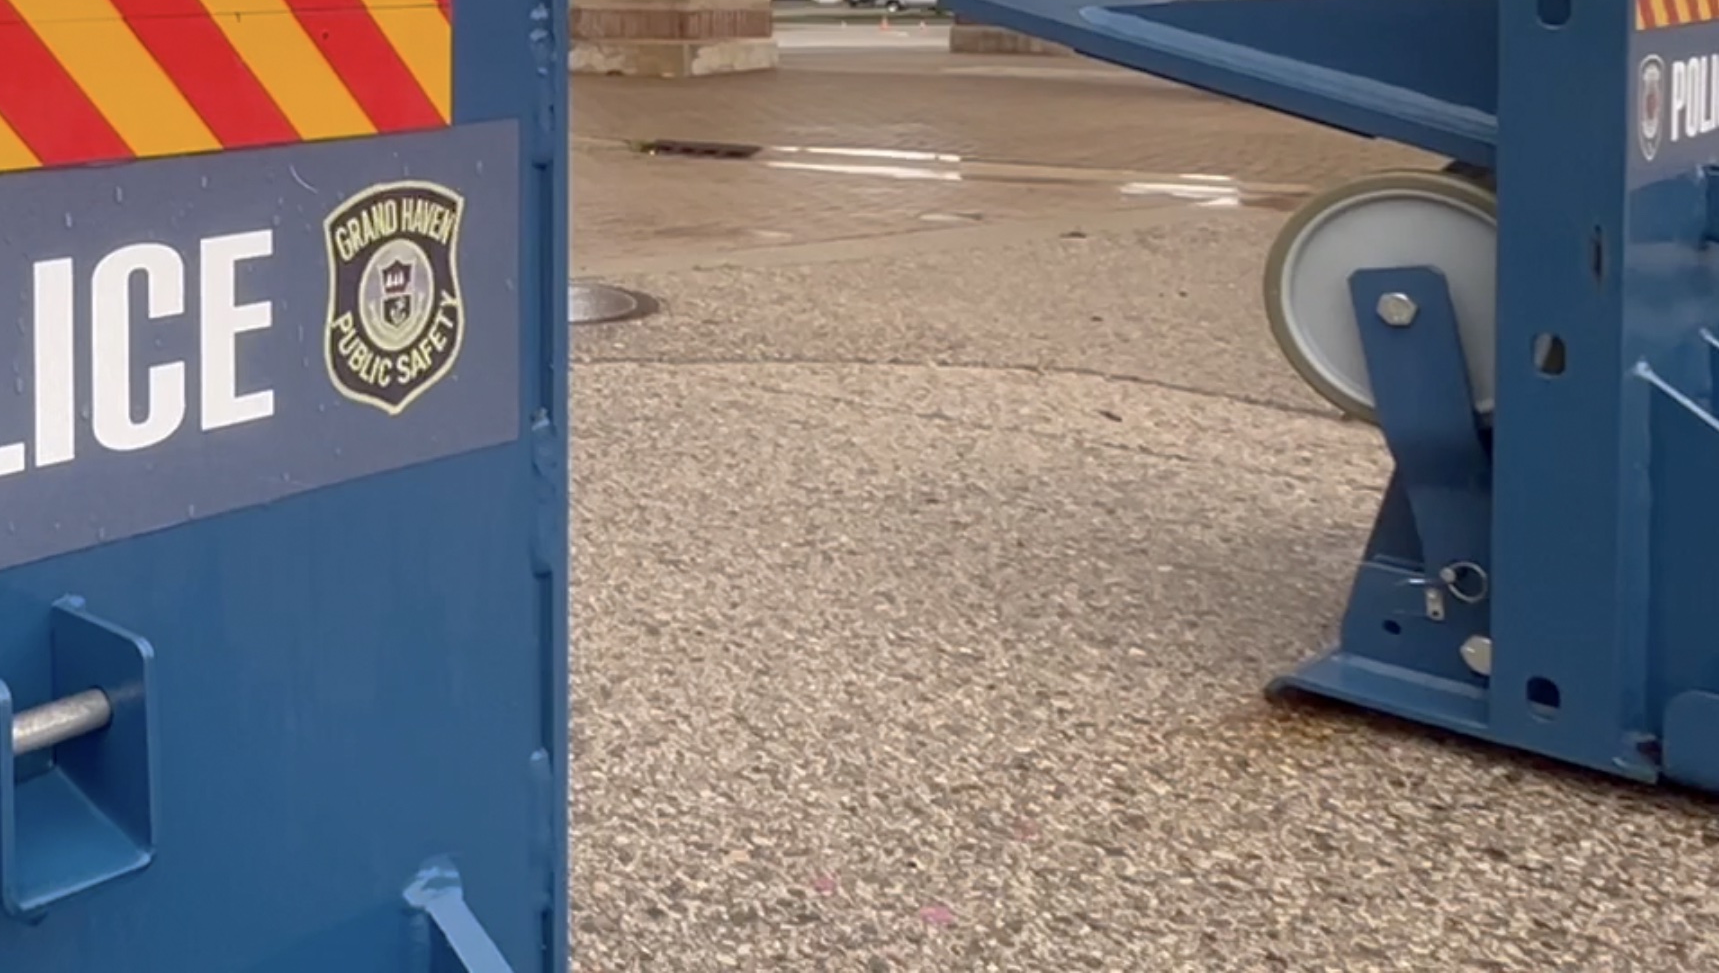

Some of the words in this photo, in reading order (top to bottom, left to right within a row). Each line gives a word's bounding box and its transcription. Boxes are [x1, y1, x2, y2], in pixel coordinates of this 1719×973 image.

[1671, 54, 1719, 141] POLI
[335, 199, 397, 262] GRAND
[401, 198, 455, 245] HAVEN
[331, 311, 393, 387] PUBLIC
[396, 290, 459, 383] SAFETY
